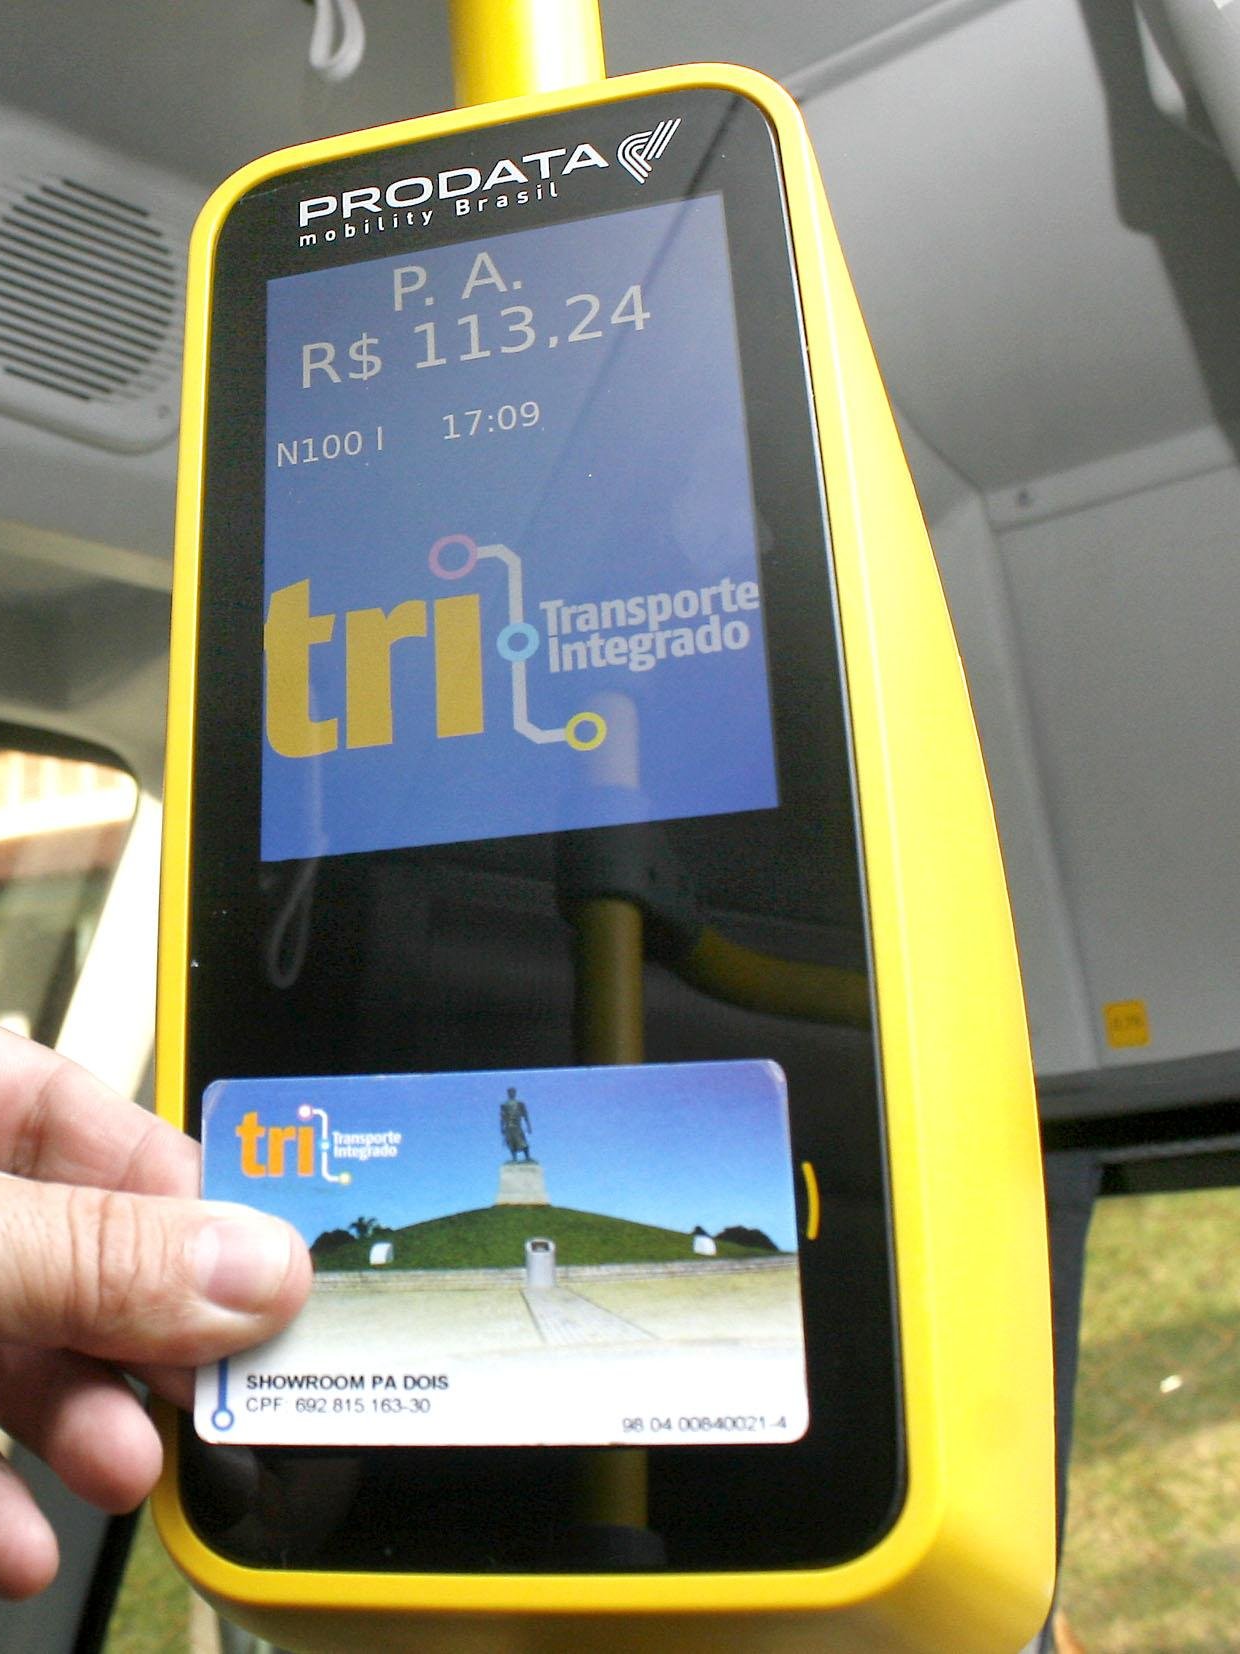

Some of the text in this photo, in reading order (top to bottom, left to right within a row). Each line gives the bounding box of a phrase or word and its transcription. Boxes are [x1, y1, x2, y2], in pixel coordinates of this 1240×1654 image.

[299, 143, 609, 228] PRODATA
[299, 180, 559, 248] mobility Brasil
[392, 251, 523, 312] P. A.
[301, 332, 383, 389] R$
[276, 430, 362, 467] N100
[442, 401, 540, 440] 17:09
[540, 577, 761, 635] Transporte
[263, 578, 484, 758] tri
[548, 617, 751, 672] Integrado
[235, 1110, 315, 1178] tri
[332, 1130, 402, 1147] Transporte
[333, 1144, 398, 1161] Integrado
[246, 1374, 450, 1391] SHOWROOM PA DOIS
[371, 1397, 432, 1414] 163-30
